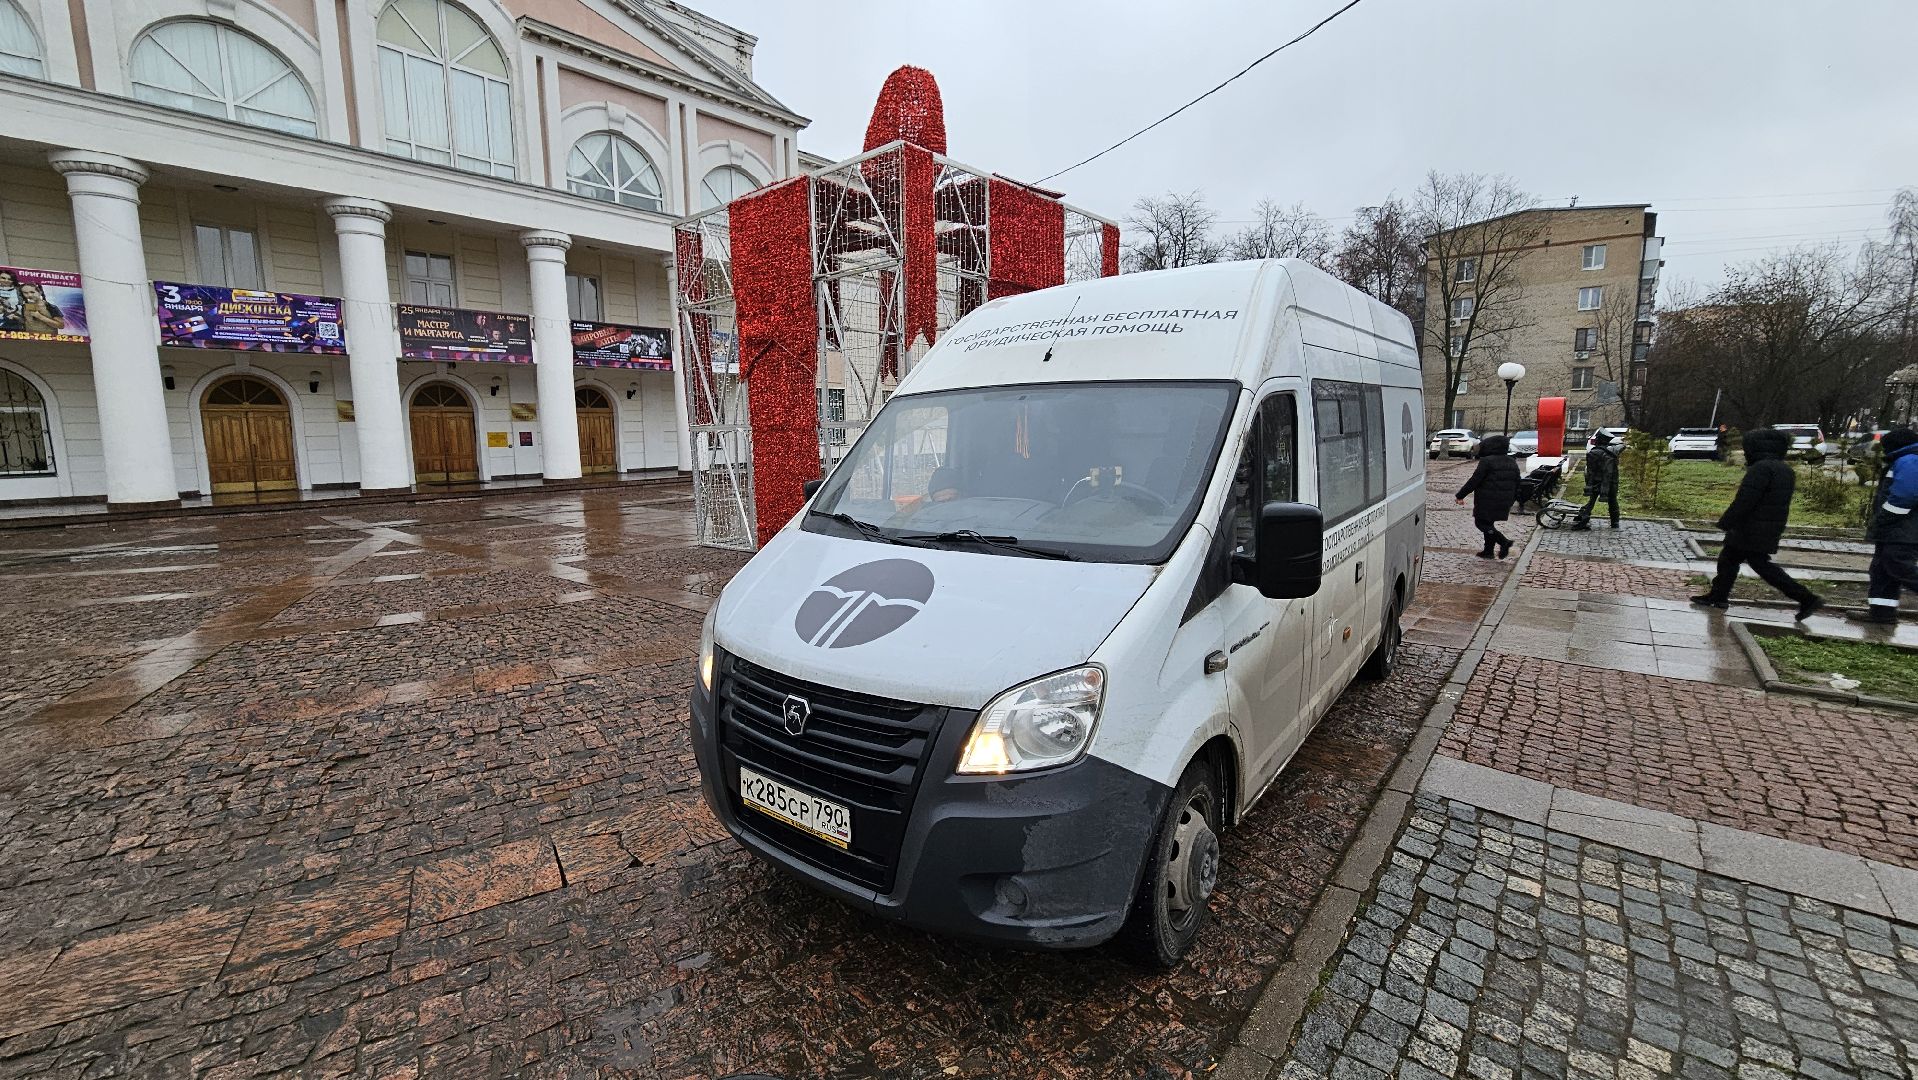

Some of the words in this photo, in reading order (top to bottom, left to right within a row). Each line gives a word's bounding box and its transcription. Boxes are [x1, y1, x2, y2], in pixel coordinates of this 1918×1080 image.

[162, 285, 181, 303] 3
[164, 303, 204, 312] ЯНВАРЯ
[218, 302, 292, 316] ДИСКОТЕКА
[401, 306, 414, 315] 25
[414, 307, 441, 315] ЯНВАРЯ
[417, 320, 450, 330] МАСТЕР
[947, 314, 1099, 347] ГОСУДАРСТВЕННАЯ
[1102, 309, 1239, 322] БЕСПЛАТНАЯ
[404, 327, 412, 336] И
[413, 328, 465, 340] МАРГАРИТА
[964, 326, 1088, 352] ЮРИДИЧЕСКАЯ
[1094, 322, 1185, 336] ПОМОЩЬ
[813, 800, 844, 828] 790
[821, 821, 837, 834] RUS
